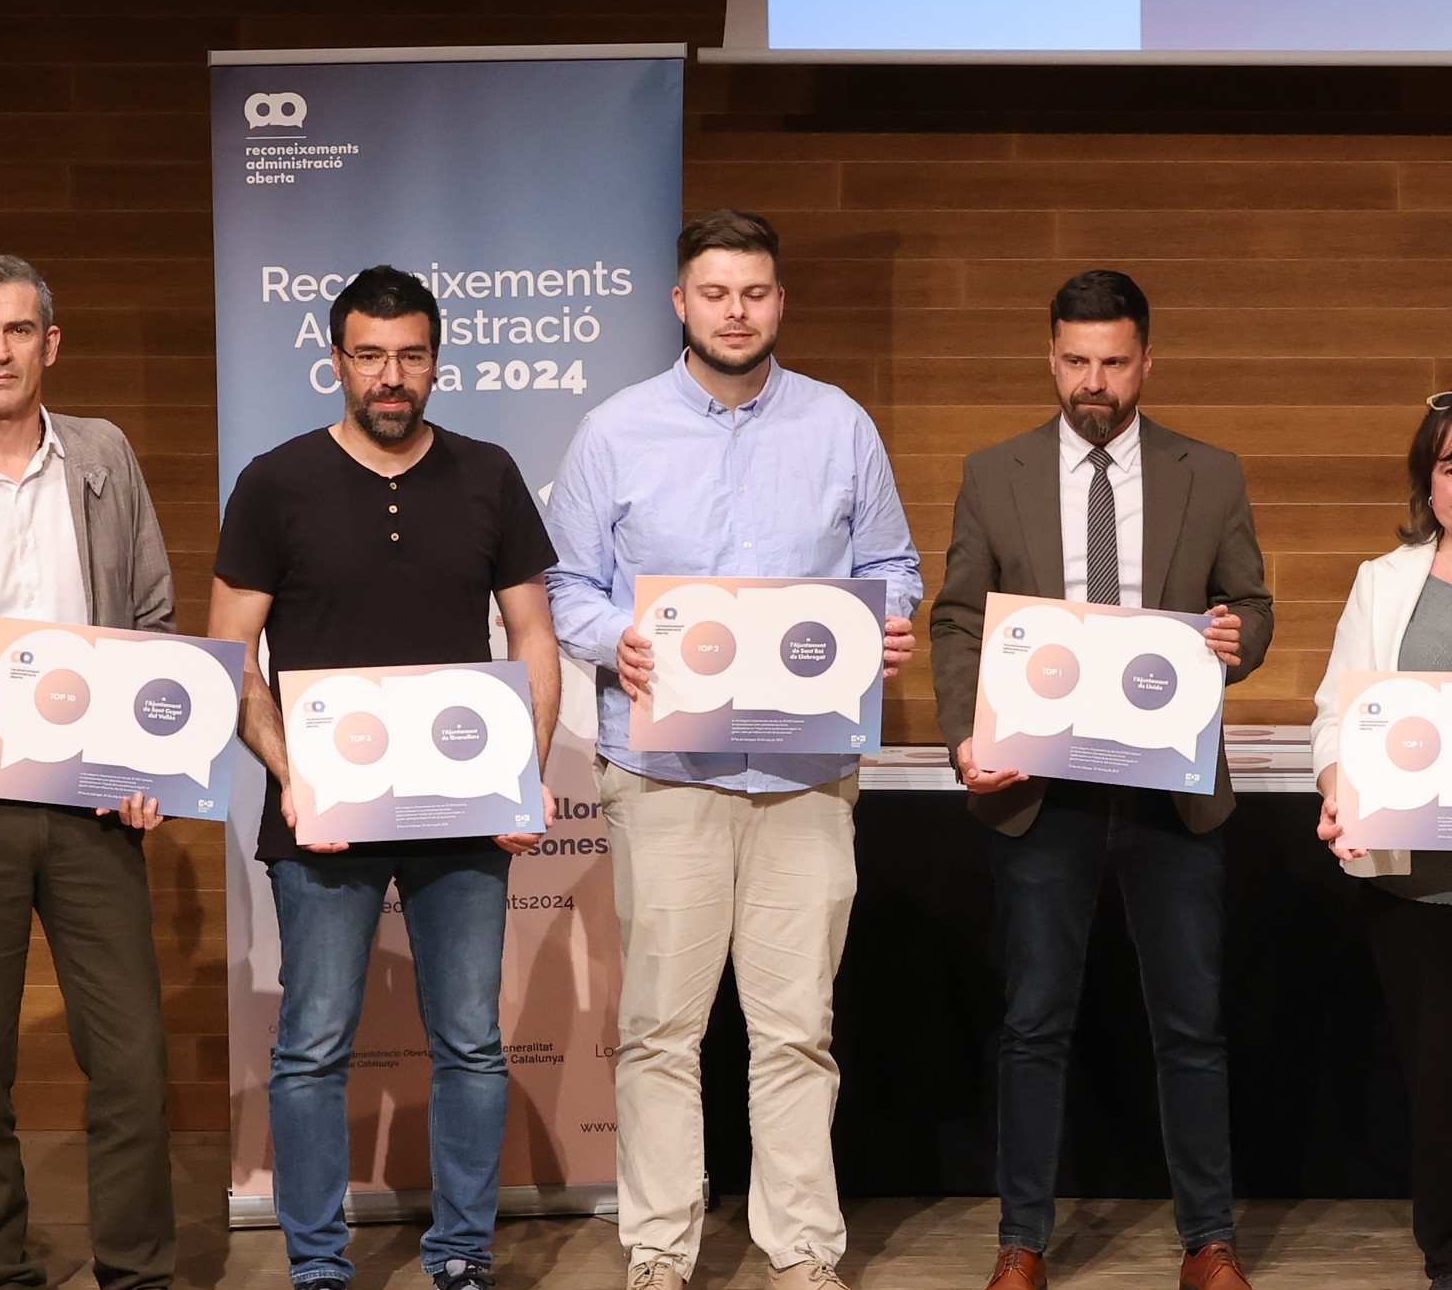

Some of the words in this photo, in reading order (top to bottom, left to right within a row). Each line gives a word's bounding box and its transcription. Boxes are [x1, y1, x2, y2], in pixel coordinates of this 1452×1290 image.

[245, 142, 359, 157] reconeixements
[245, 156, 343, 171] administració
[245, 171, 295, 185] oberta
[261, 261, 633, 303] Recixements
[294, 305, 601, 349] Aistració
[475, 359, 588, 395] 2024
[503, 1042, 553, 1053] eneralitat
[510, 1054, 564, 1065] Catalunya
